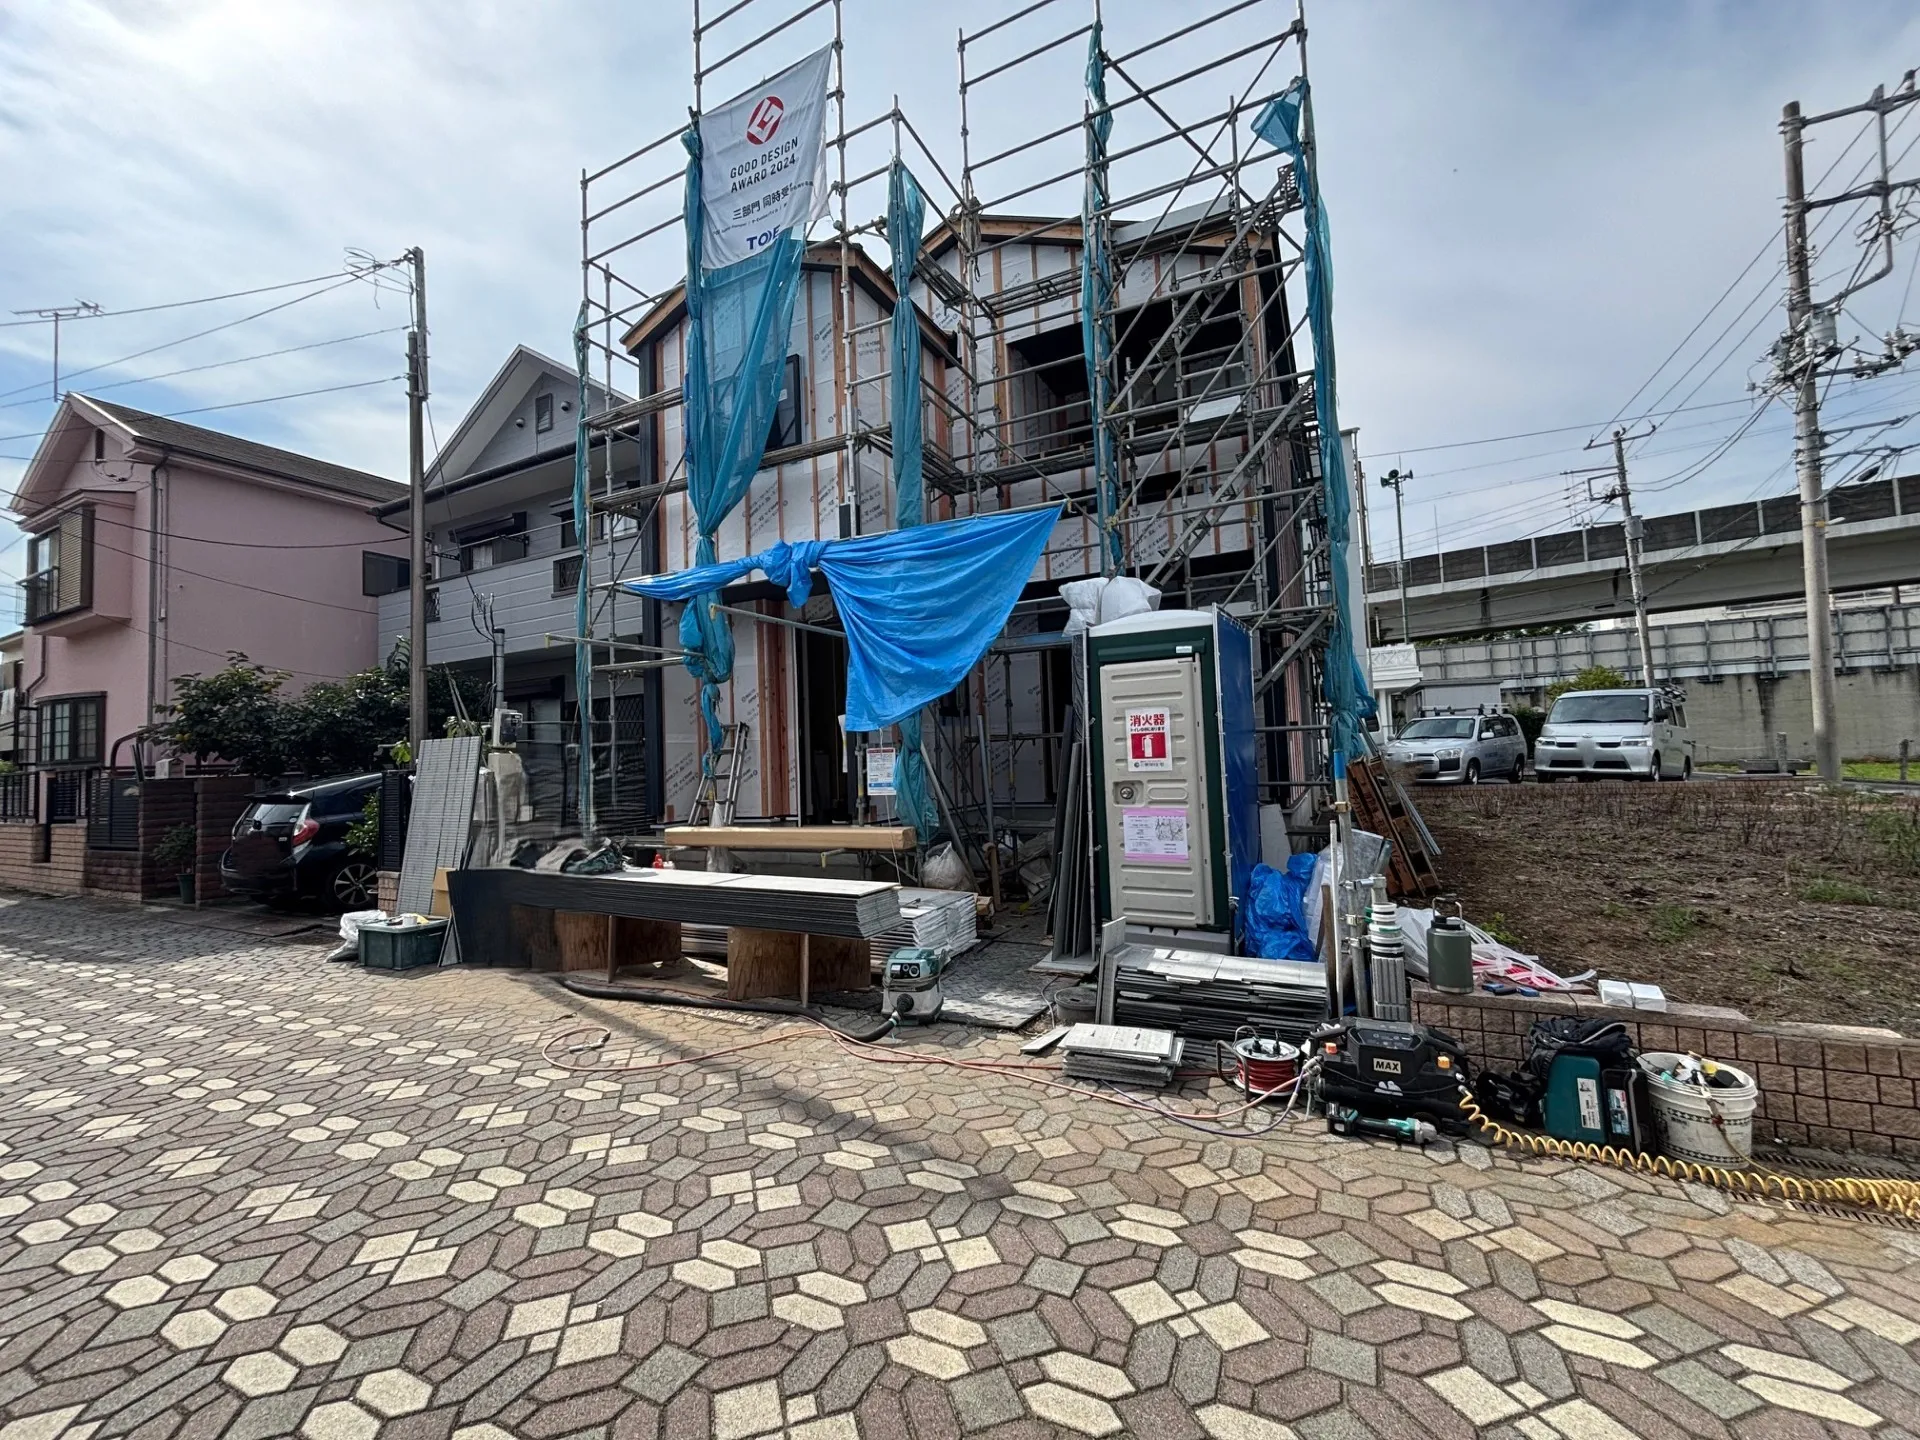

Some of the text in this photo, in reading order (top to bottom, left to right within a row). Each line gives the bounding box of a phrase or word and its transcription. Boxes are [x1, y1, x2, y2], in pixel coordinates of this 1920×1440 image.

[730, 136, 798, 179] GOOD DESIGN
[731, 168, 767, 193] AWARD
[770, 152, 796, 176] 2024
[732, 200, 760, 220] 三部門
[1129, 713, 1166, 727] 消火器
[1375, 1060, 1399, 1071] MAX
